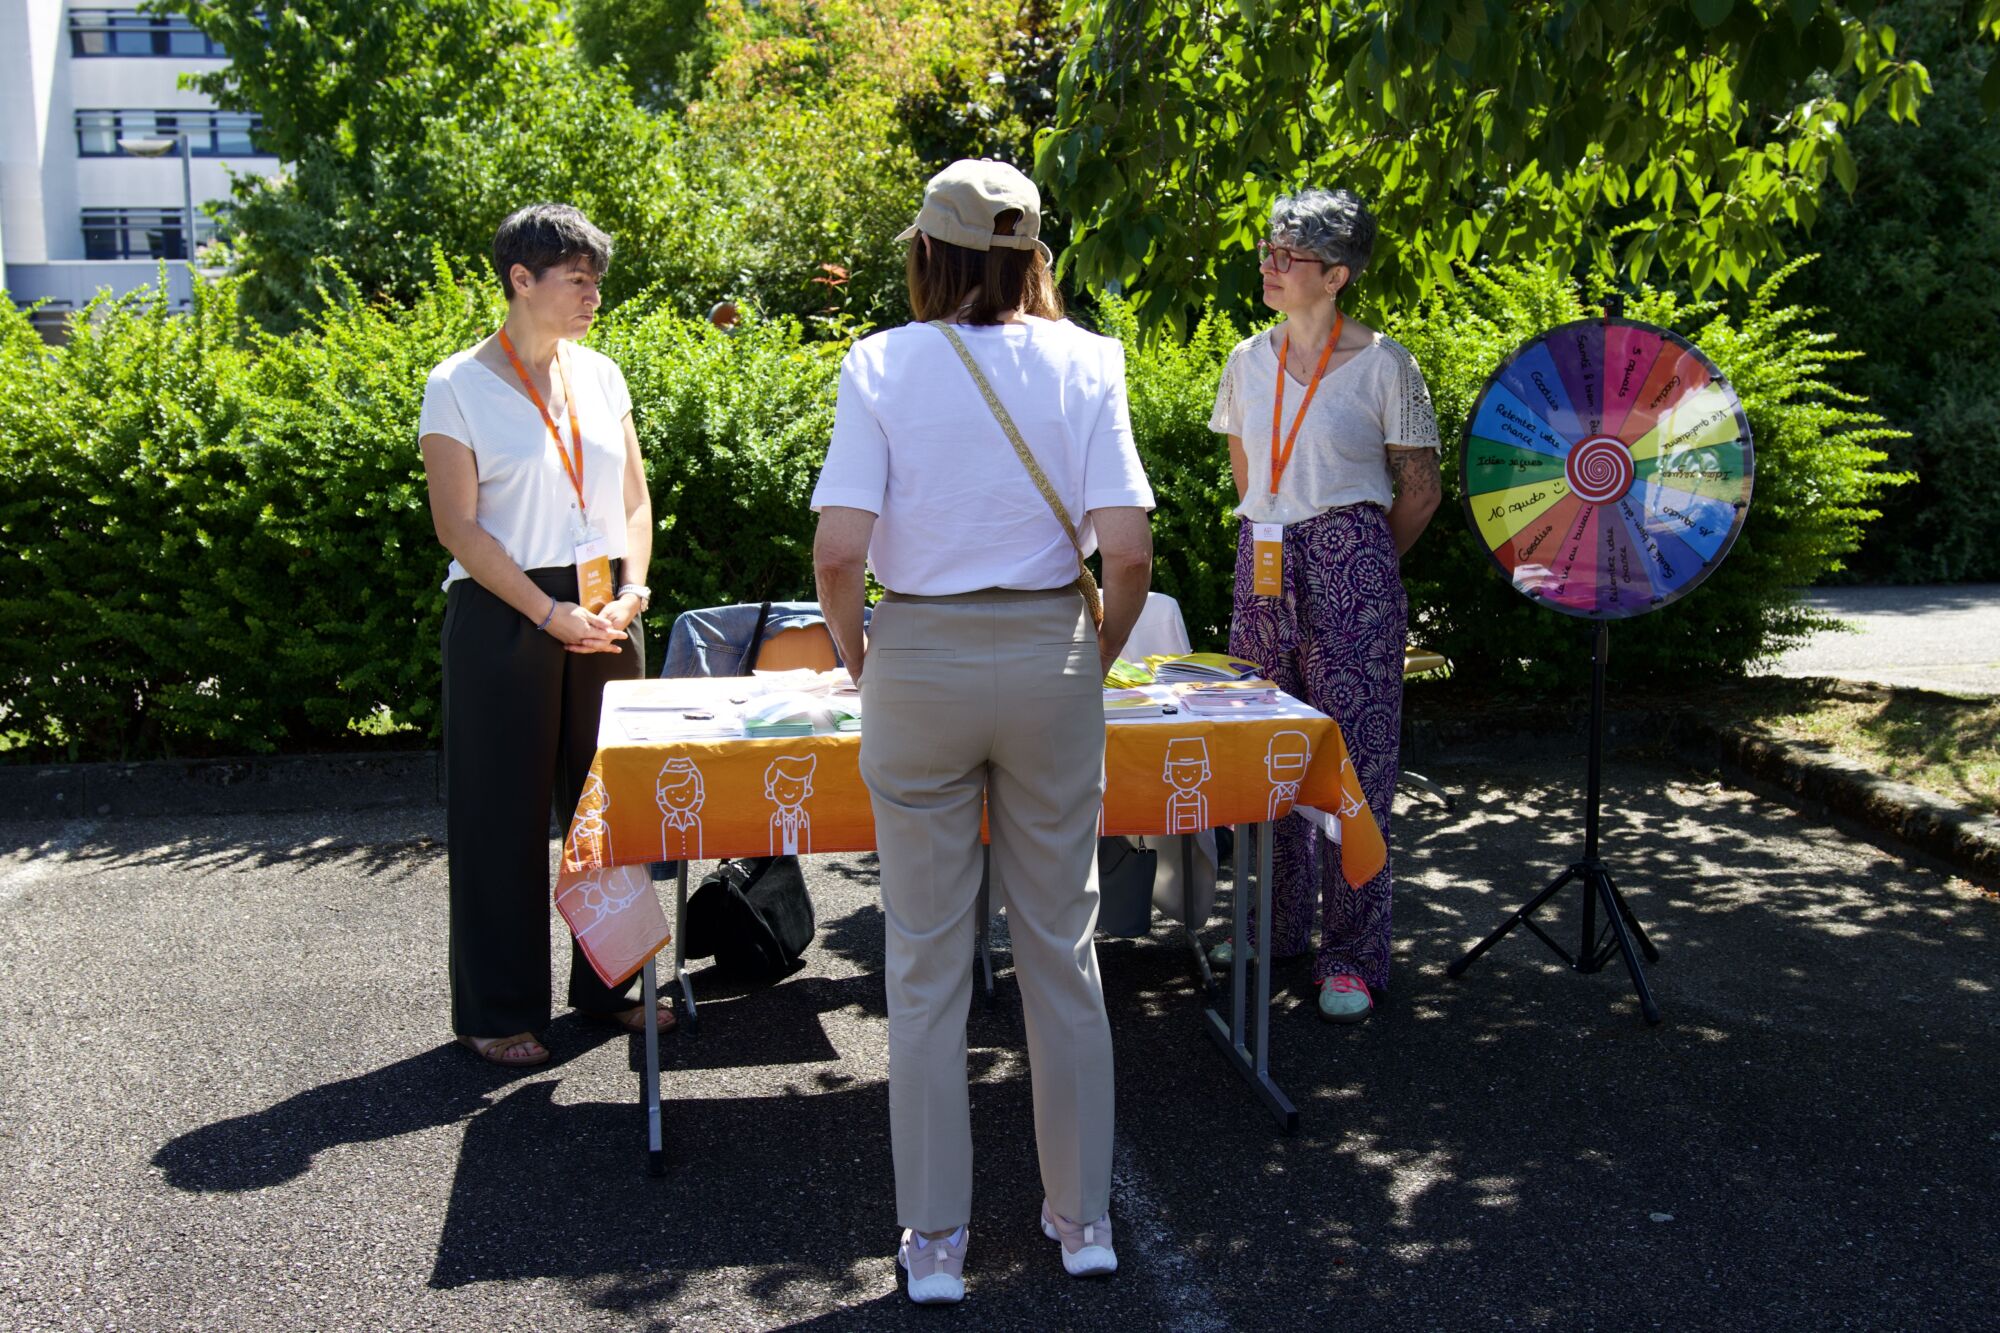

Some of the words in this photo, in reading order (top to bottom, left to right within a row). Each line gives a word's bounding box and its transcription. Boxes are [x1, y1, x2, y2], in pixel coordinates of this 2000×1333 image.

[1530, 371, 1559, 412] Goodies
[1618, 359, 1636, 399] squats
[1650, 375, 1681, 410] Goodies
[1495, 402, 1537, 434] Retentez
[1501, 423, 1533, 447] chance
[1487, 506, 1505, 522] 10
[1508, 492, 1546, 514] squats
[1574, 505, 1594, 541] bureau
[1662, 506, 1697, 530] squats
[1518, 524, 1553, 562] Goodies
